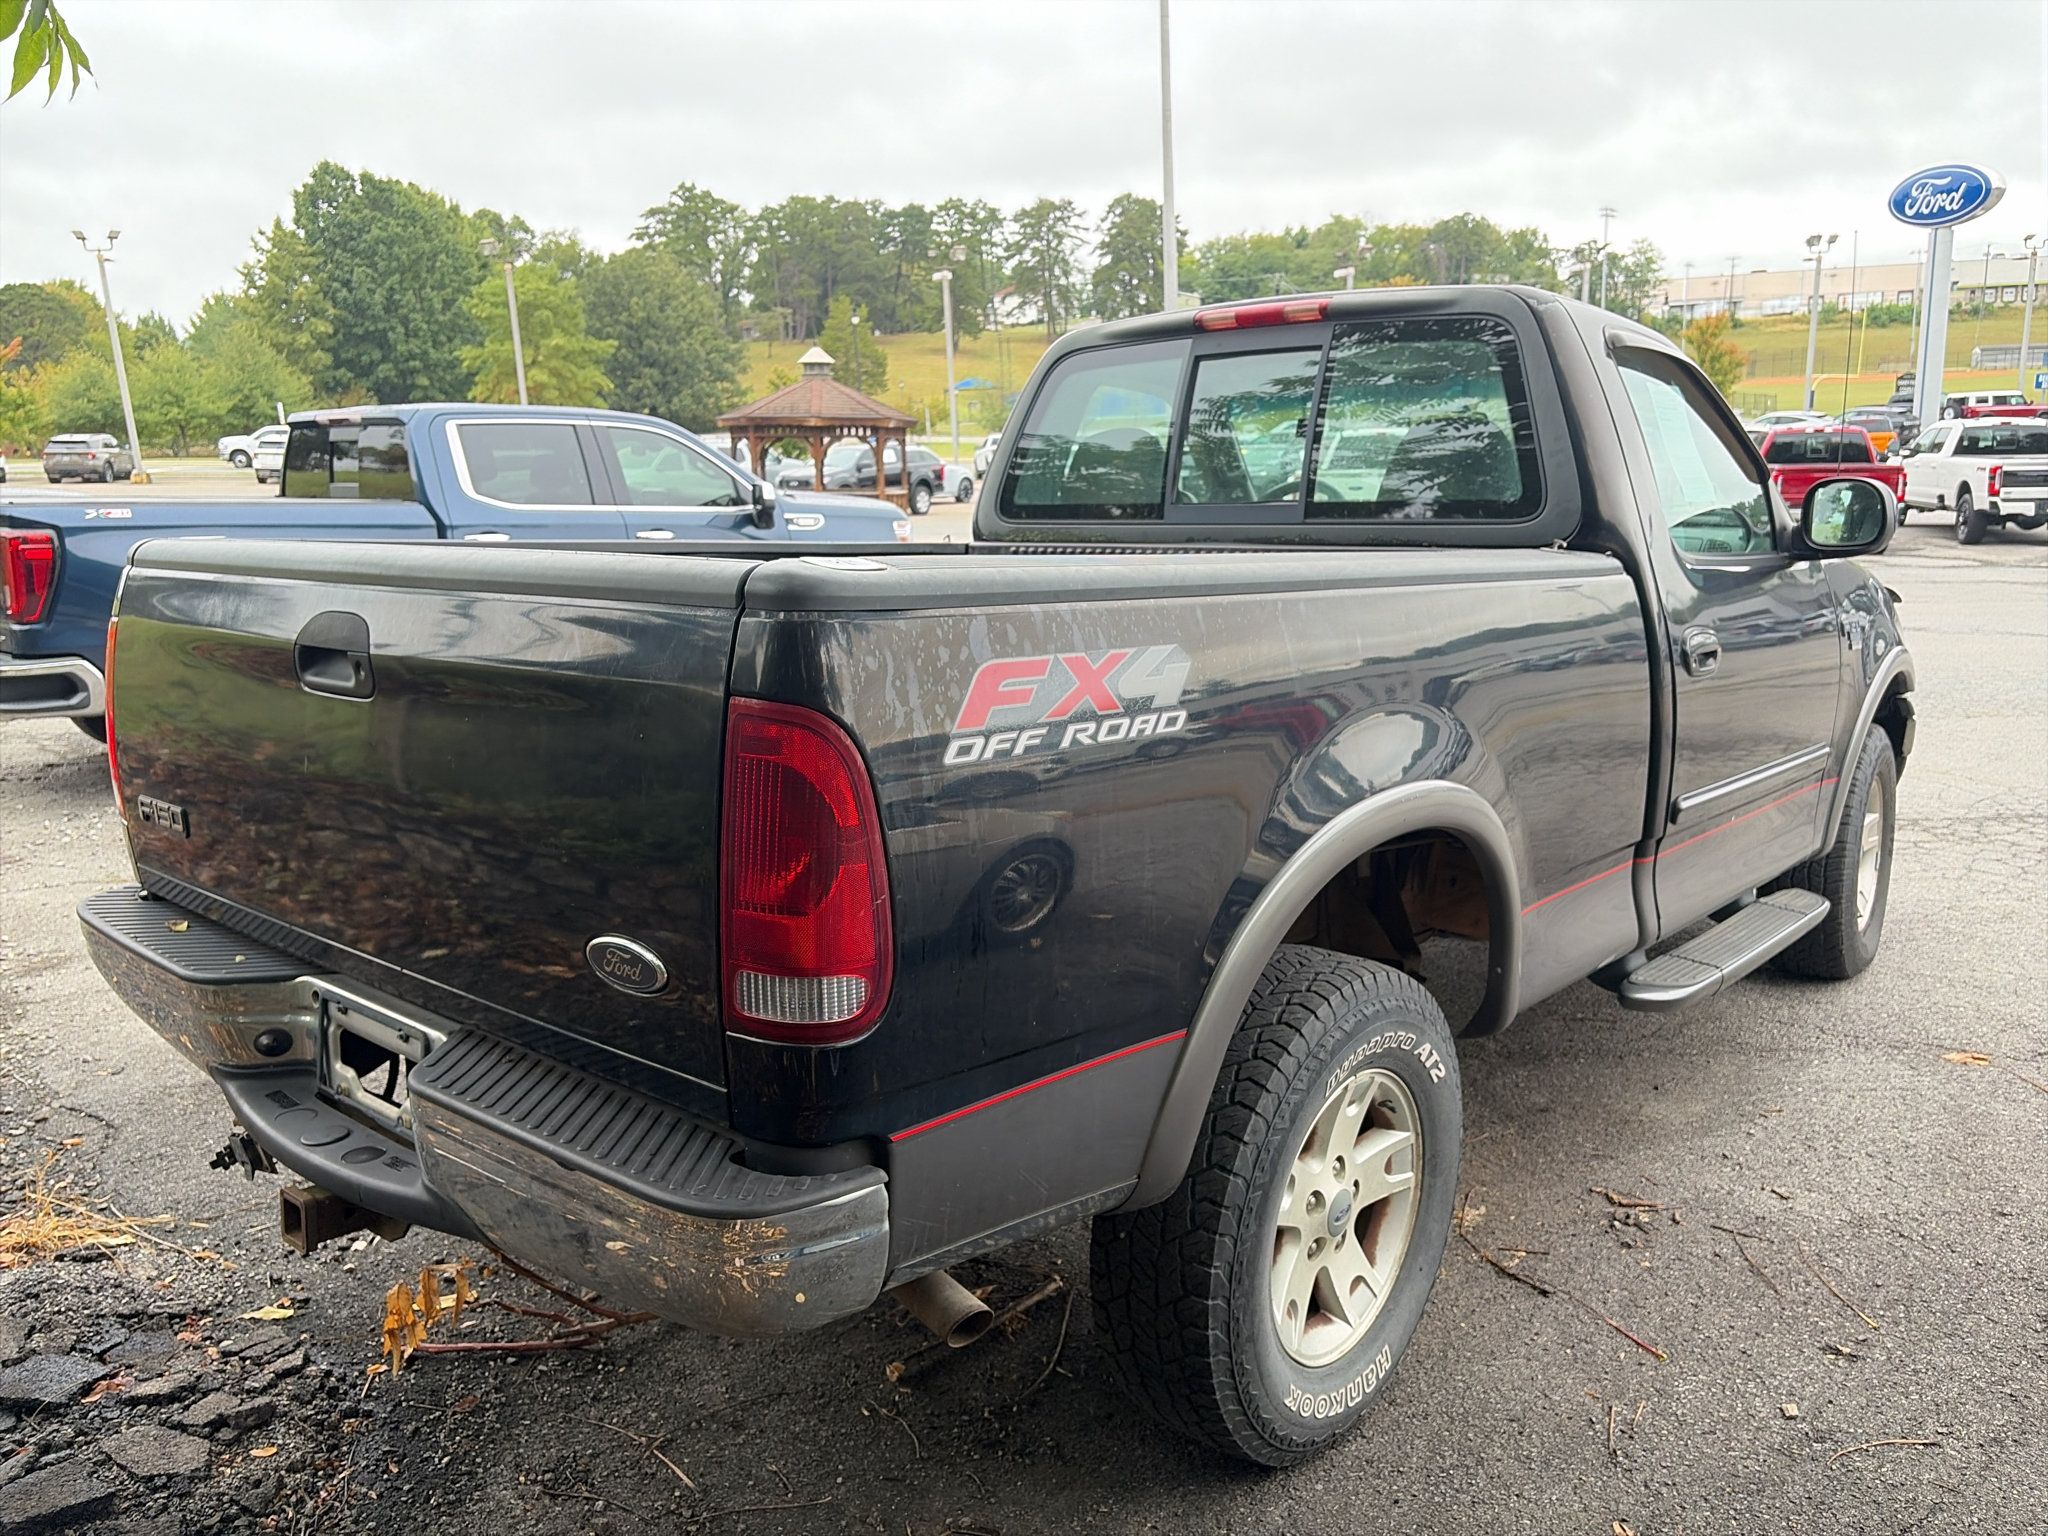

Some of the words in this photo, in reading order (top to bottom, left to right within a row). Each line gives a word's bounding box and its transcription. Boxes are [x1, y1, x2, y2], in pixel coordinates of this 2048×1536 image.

[1904, 176, 1967, 217] Ford
[951, 644, 1191, 733] FX4
[943, 726, 1049, 766] OFF
[1058, 710, 1187, 750] ROAD
[603, 948, 642, 981] Ford
[1413, 1042, 1447, 1084] AT2
